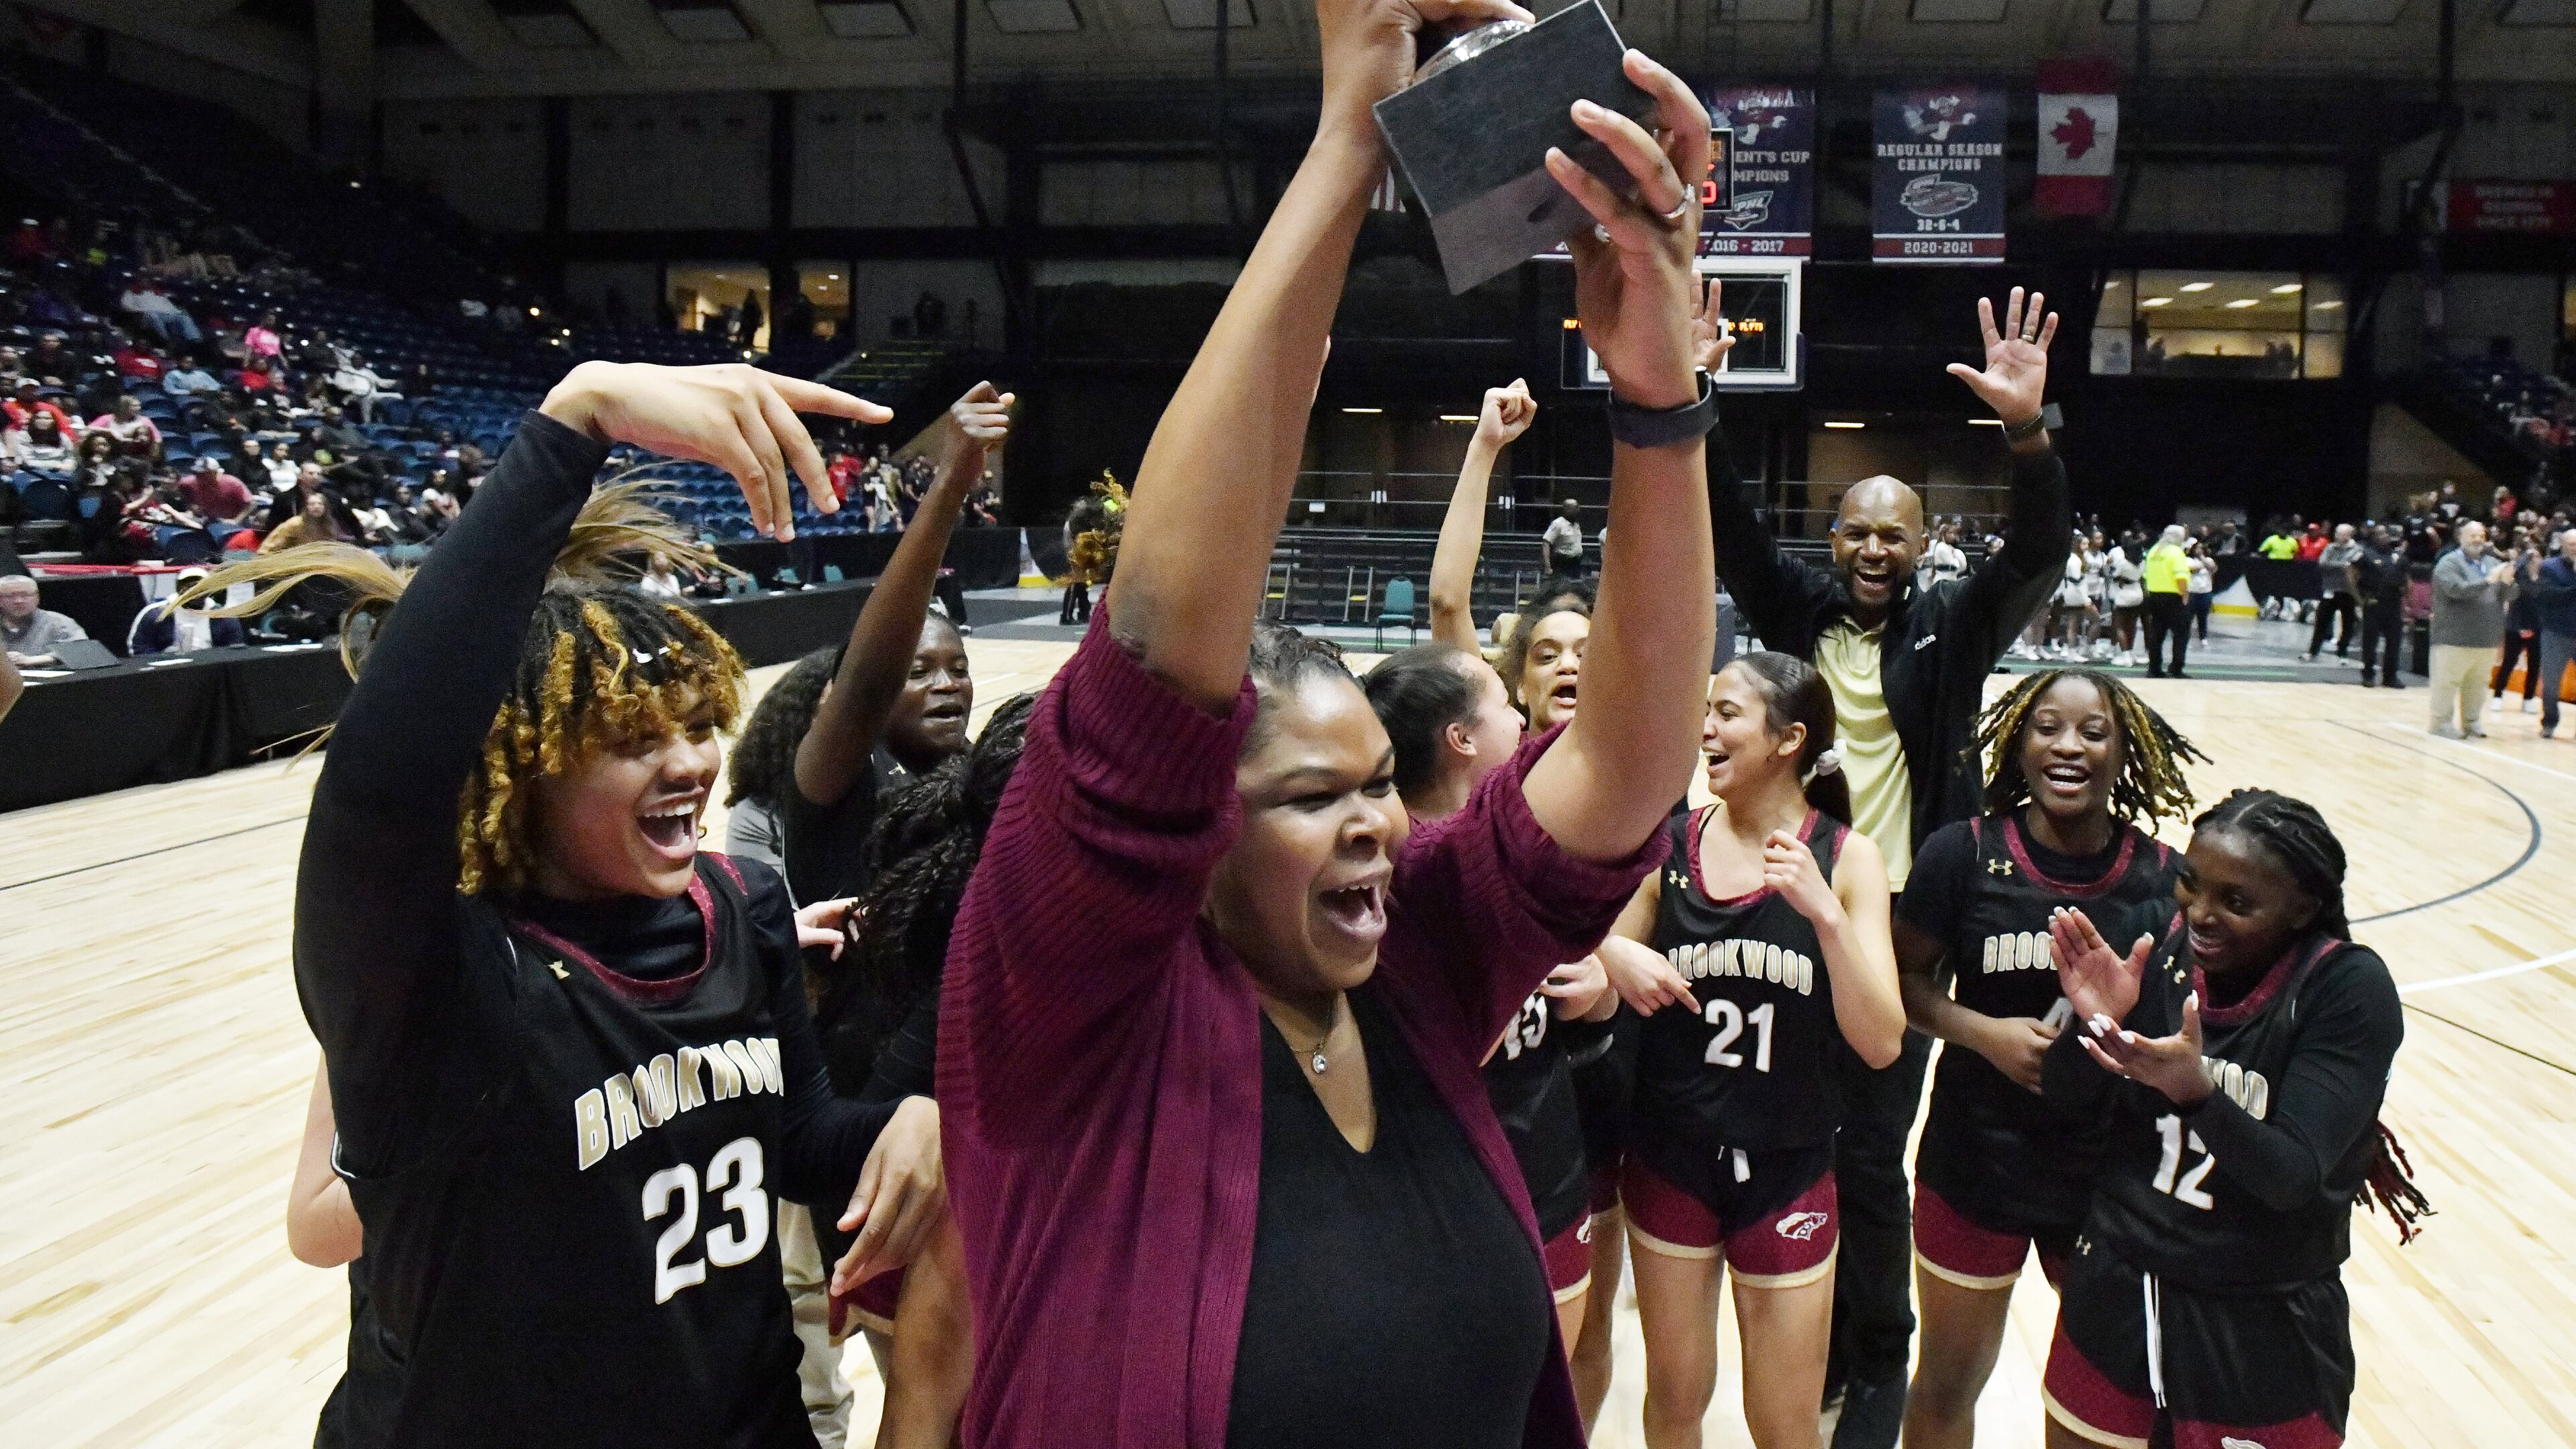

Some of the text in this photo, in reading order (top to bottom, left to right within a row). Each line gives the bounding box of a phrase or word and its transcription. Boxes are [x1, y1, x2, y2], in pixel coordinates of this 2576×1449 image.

[1878, 142, 2003, 157] REGULAR SEASON
[1735, 150, 1810, 164] ENT'S CUP
[1898, 157, 1981, 171] CHAMPIONS
[1733, 170, 1789, 182] MPIONS
[1752, 239, 1784, 252] 2017
[1904, 241, 1974, 254] 2020-2021
[1983, 931, 2058, 974] BROO
[1704, 998, 1774, 1073] 21
[2152, 1113, 2216, 1211] 12
[641, 1136, 770, 1305] 23
